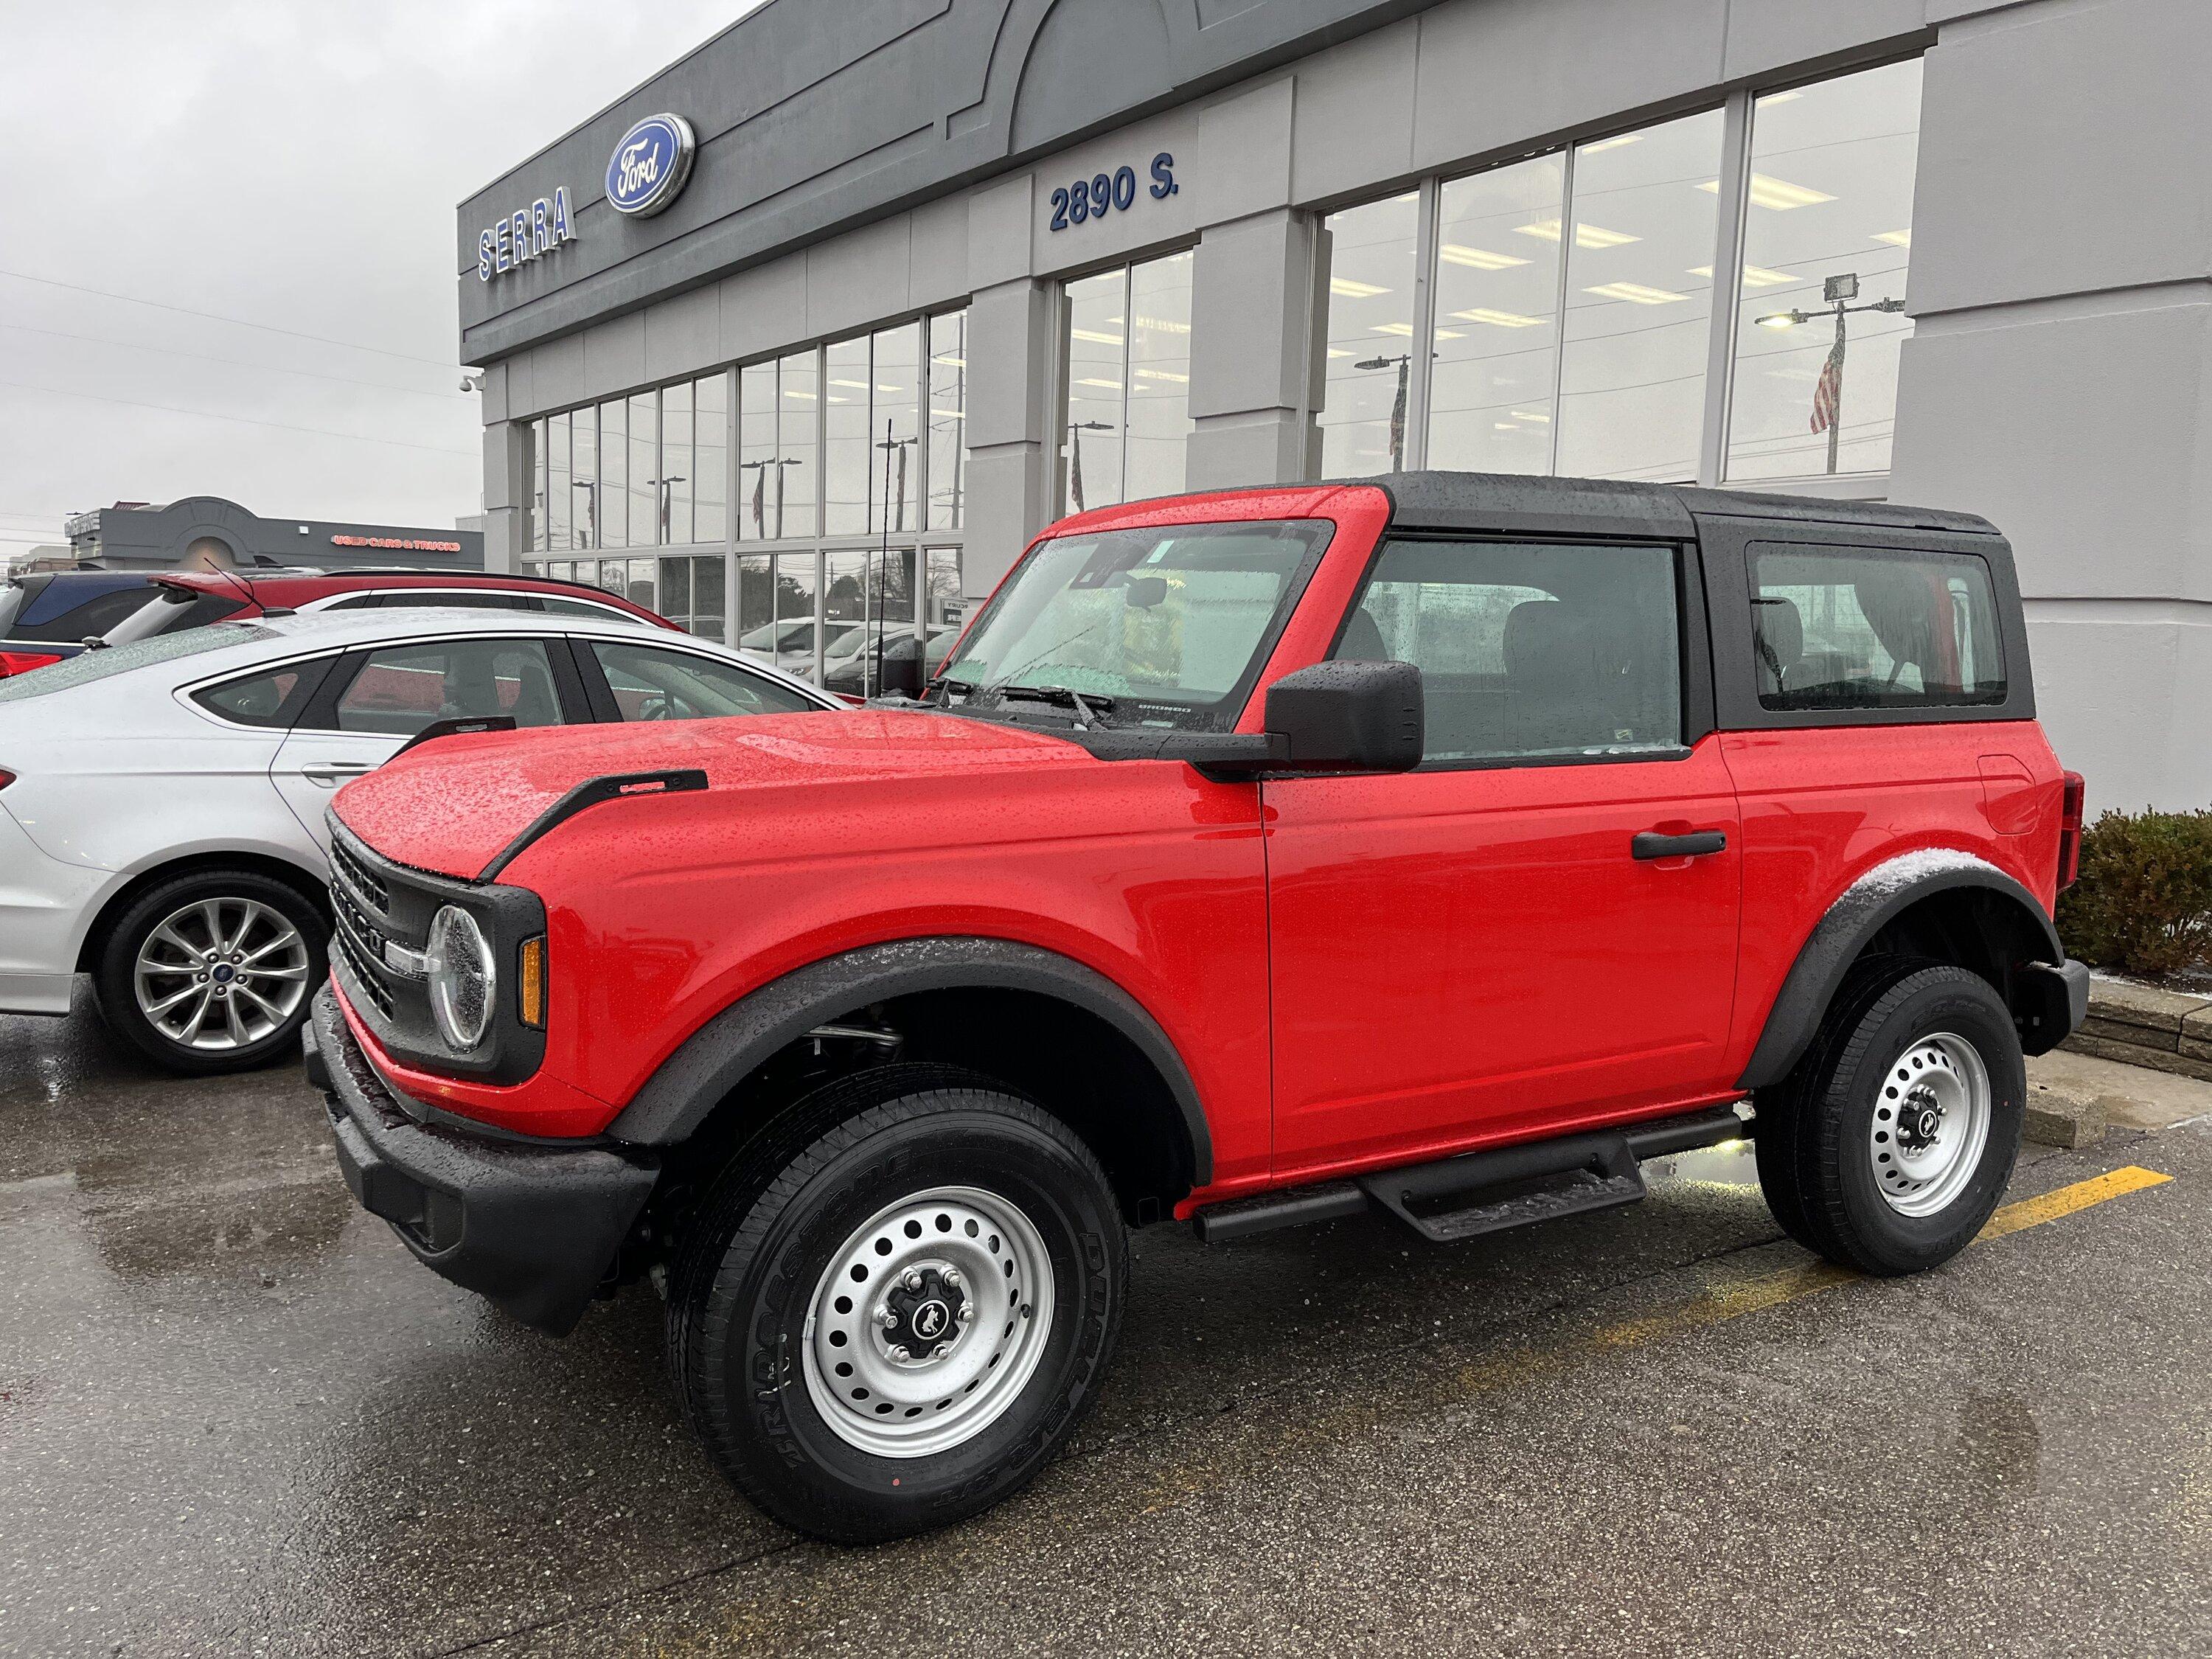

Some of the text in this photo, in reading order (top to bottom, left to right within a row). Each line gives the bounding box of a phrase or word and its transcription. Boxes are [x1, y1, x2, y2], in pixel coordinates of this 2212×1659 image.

[616, 137, 660, 198] Ford
[1050, 152, 1179, 232] 2890 S.
[479, 186, 577, 282] SERRA
[333, 535, 461, 552] USED CARS & TRUCKS
